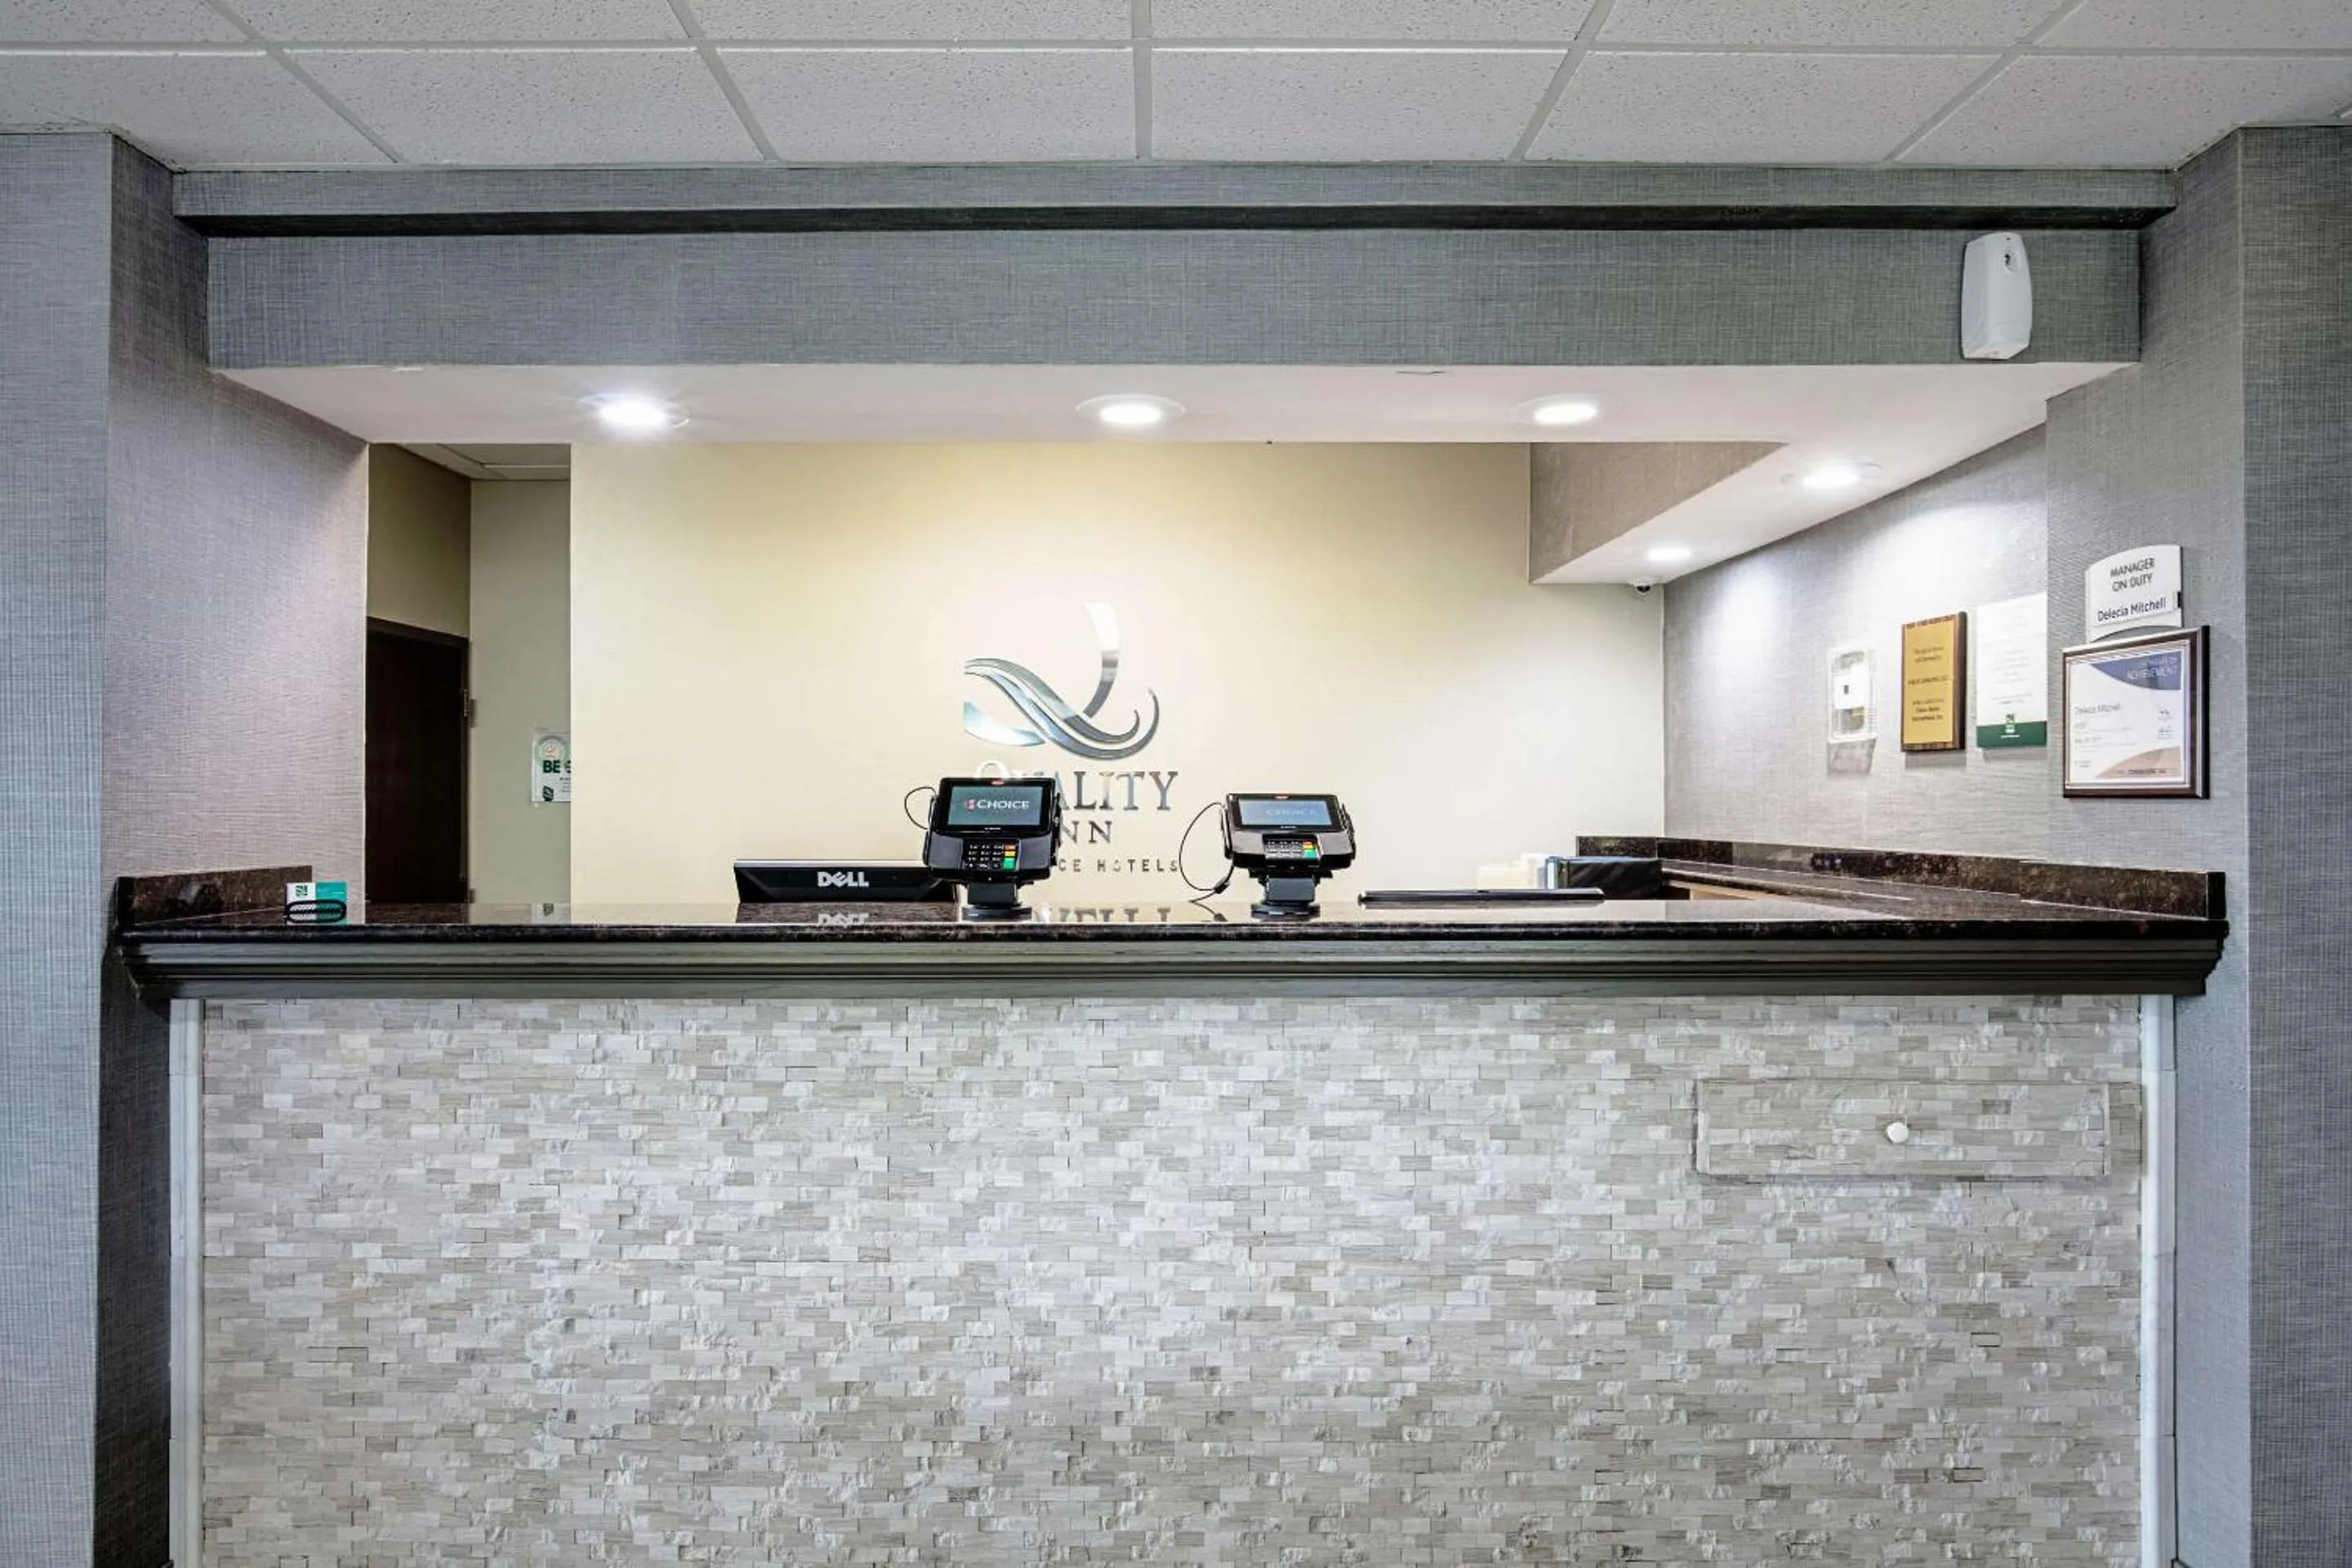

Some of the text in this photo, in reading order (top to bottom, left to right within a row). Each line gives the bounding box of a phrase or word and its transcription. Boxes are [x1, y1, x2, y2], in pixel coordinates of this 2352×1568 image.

[2110, 558, 2154, 577] MANAGER
[2112, 573, 2152, 591] ON DUTY
[2097, 597, 2166, 621] Delecia Mitchell
[543, 760, 560, 773] BE
[977, 799, 1030, 809] CHOICE
[1061, 820, 1112, 844] NN
[1097, 859, 1178, 873] HOTELS
[817, 871, 869, 887] DELL
